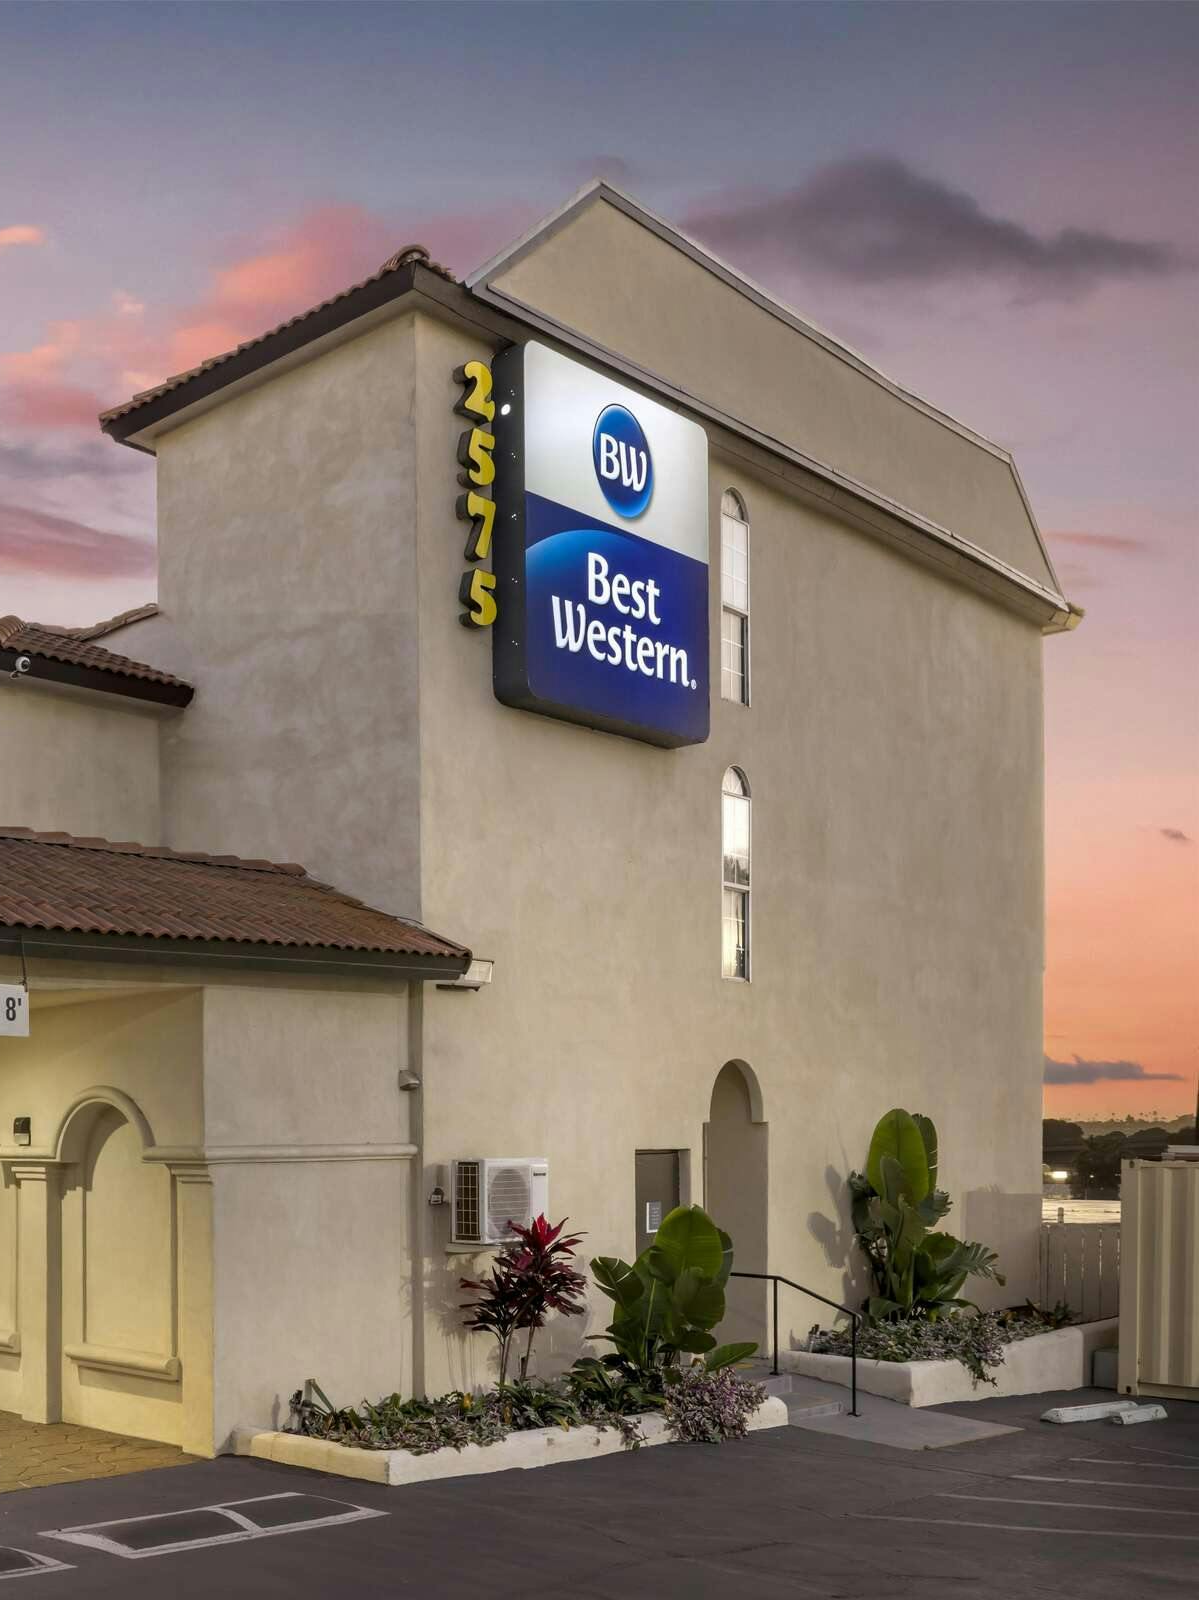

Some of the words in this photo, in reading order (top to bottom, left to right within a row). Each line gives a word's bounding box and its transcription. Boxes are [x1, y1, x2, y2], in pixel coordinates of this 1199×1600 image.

[463, 360, 498, 627] 2575
[600, 432, 648, 492] BW
[587, 551, 662, 625] Best
[5, 997, 22, 1022] 8'
